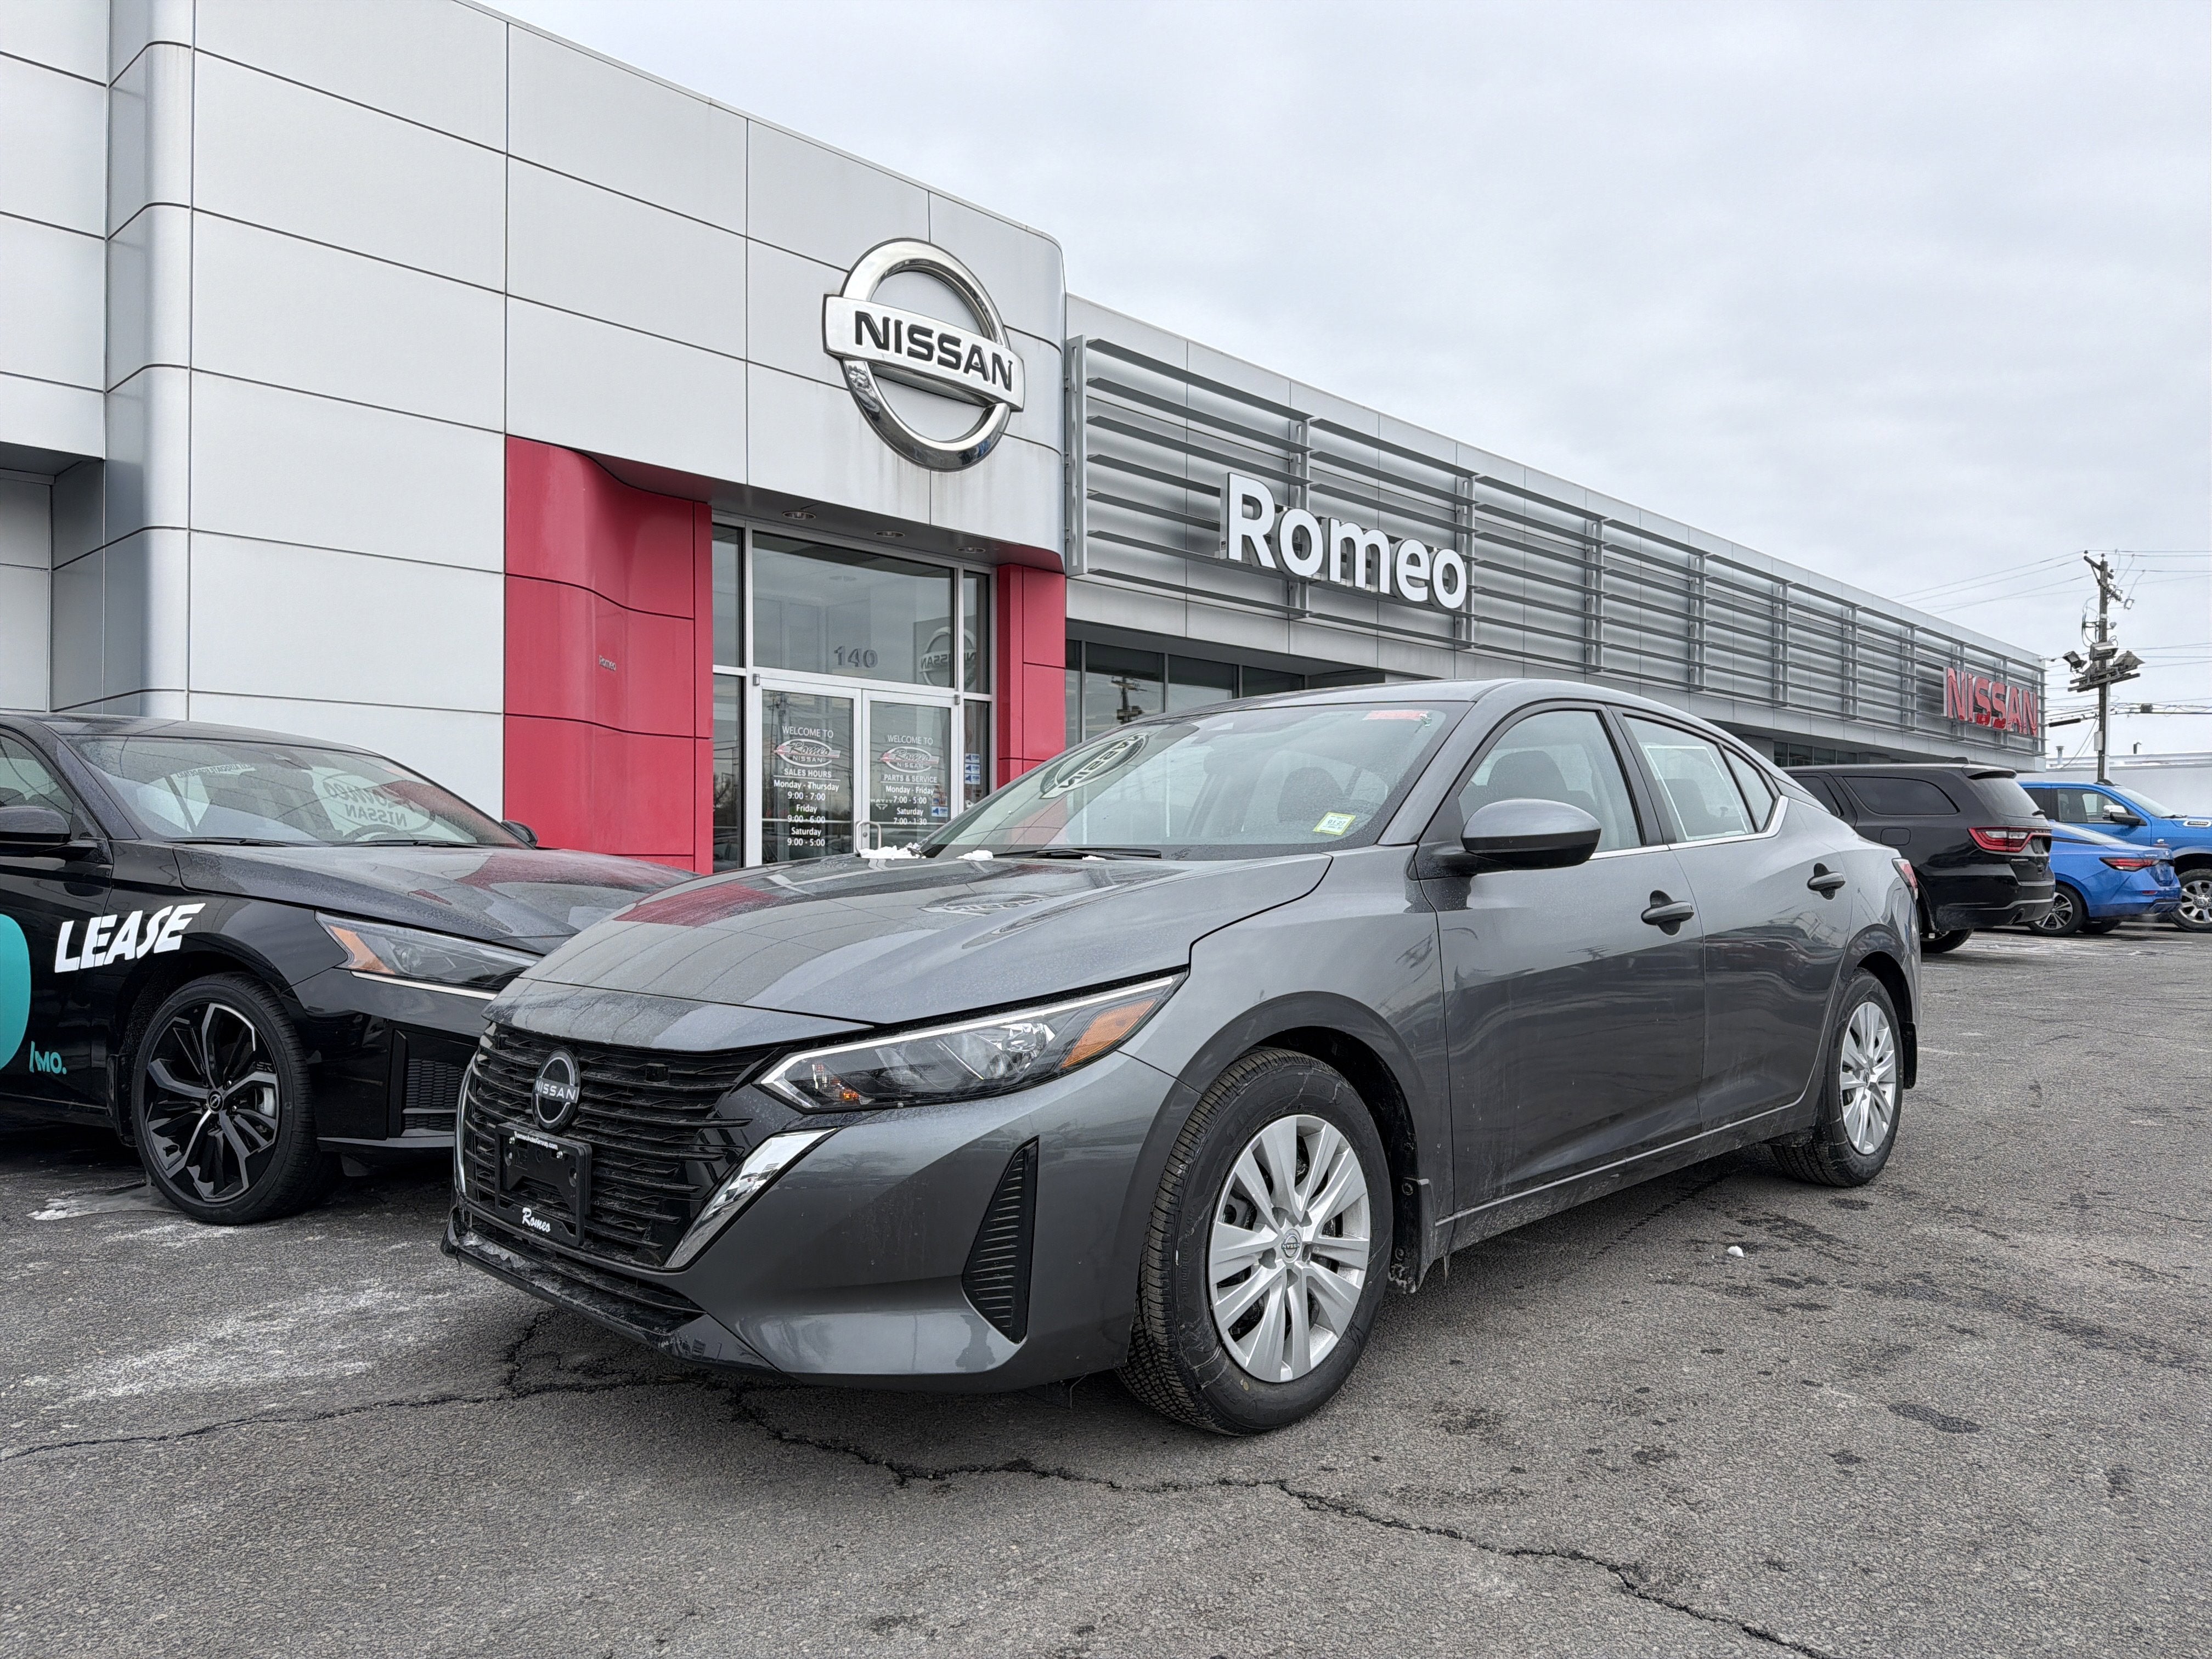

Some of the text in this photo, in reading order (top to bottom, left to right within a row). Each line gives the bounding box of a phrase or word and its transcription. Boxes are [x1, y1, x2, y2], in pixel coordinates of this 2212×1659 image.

[854, 310, 1013, 392] NISSAN
[1227, 472, 1468, 609] Romeo
[834, 646, 878, 668] 140
[1946, 667, 2038, 737] NISSAN
[782, 725, 833, 738] WELCOME TO
[887, 735, 922, 744] WELCOME
[789, 742, 830, 755] Romeo
[784, 768, 832, 778] SALES HOURS
[774, 780, 802, 790] Monday
[808, 781, 839, 792] Thursday
[885, 785, 911, 794] Monday
[916, 787, 934, 795] Friday
[787, 791, 803, 800] 9:00
[796, 804, 817, 814] Friday
[896, 807, 924, 816] Saturday
[787, 815, 804, 823] 9:00
[791, 827, 822, 837] Saturday
[810, 838, 825, 847] 5:00
[54, 903, 206, 973] LEASE
[29, 1041, 67, 1075] /MO.
[534, 1079, 576, 1101] NISSAN
[522, 1207, 551, 1233] Romeo
